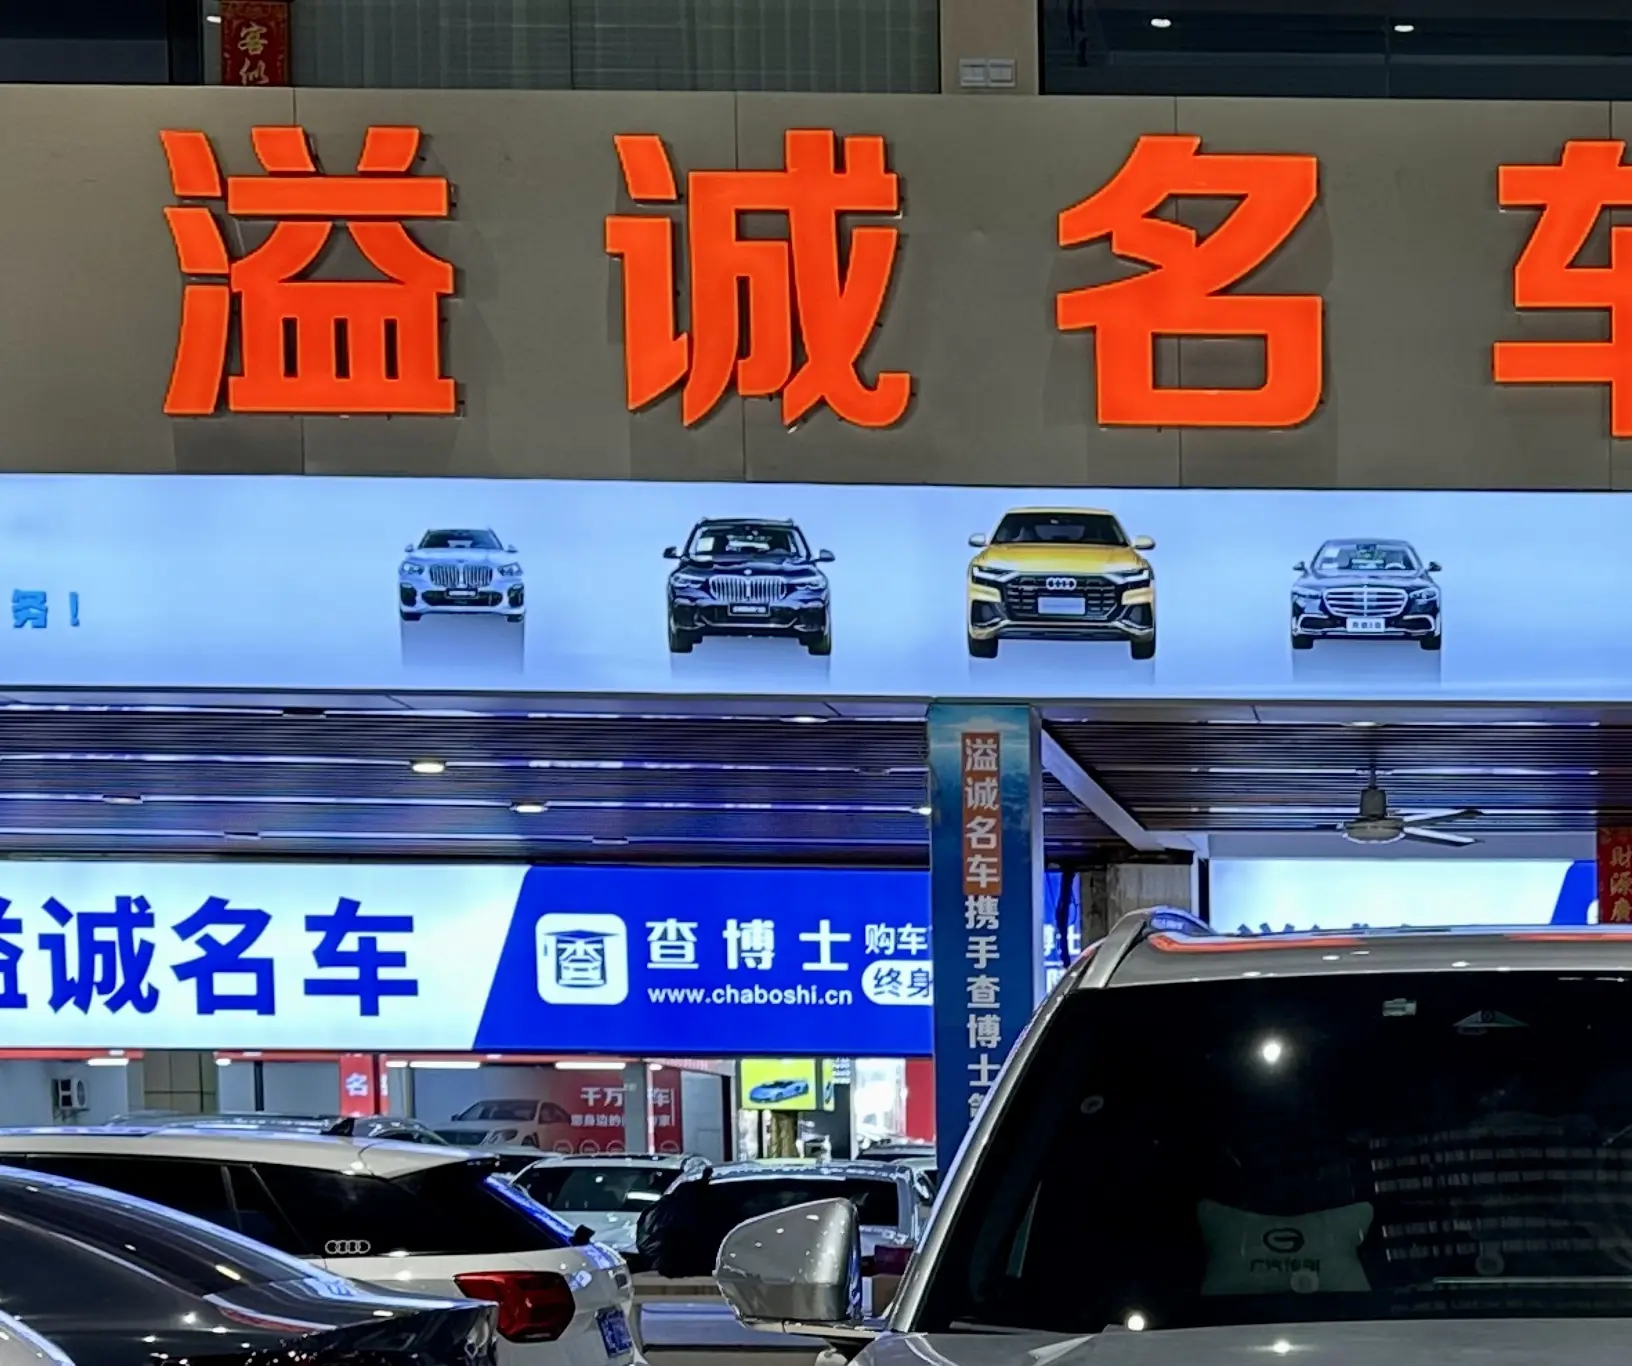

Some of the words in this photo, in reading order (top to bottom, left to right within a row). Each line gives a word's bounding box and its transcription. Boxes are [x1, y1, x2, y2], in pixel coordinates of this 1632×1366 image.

[645, 918, 851, 972] 查博士
[647, 984, 853, 1005] www.chaboshi.cn
